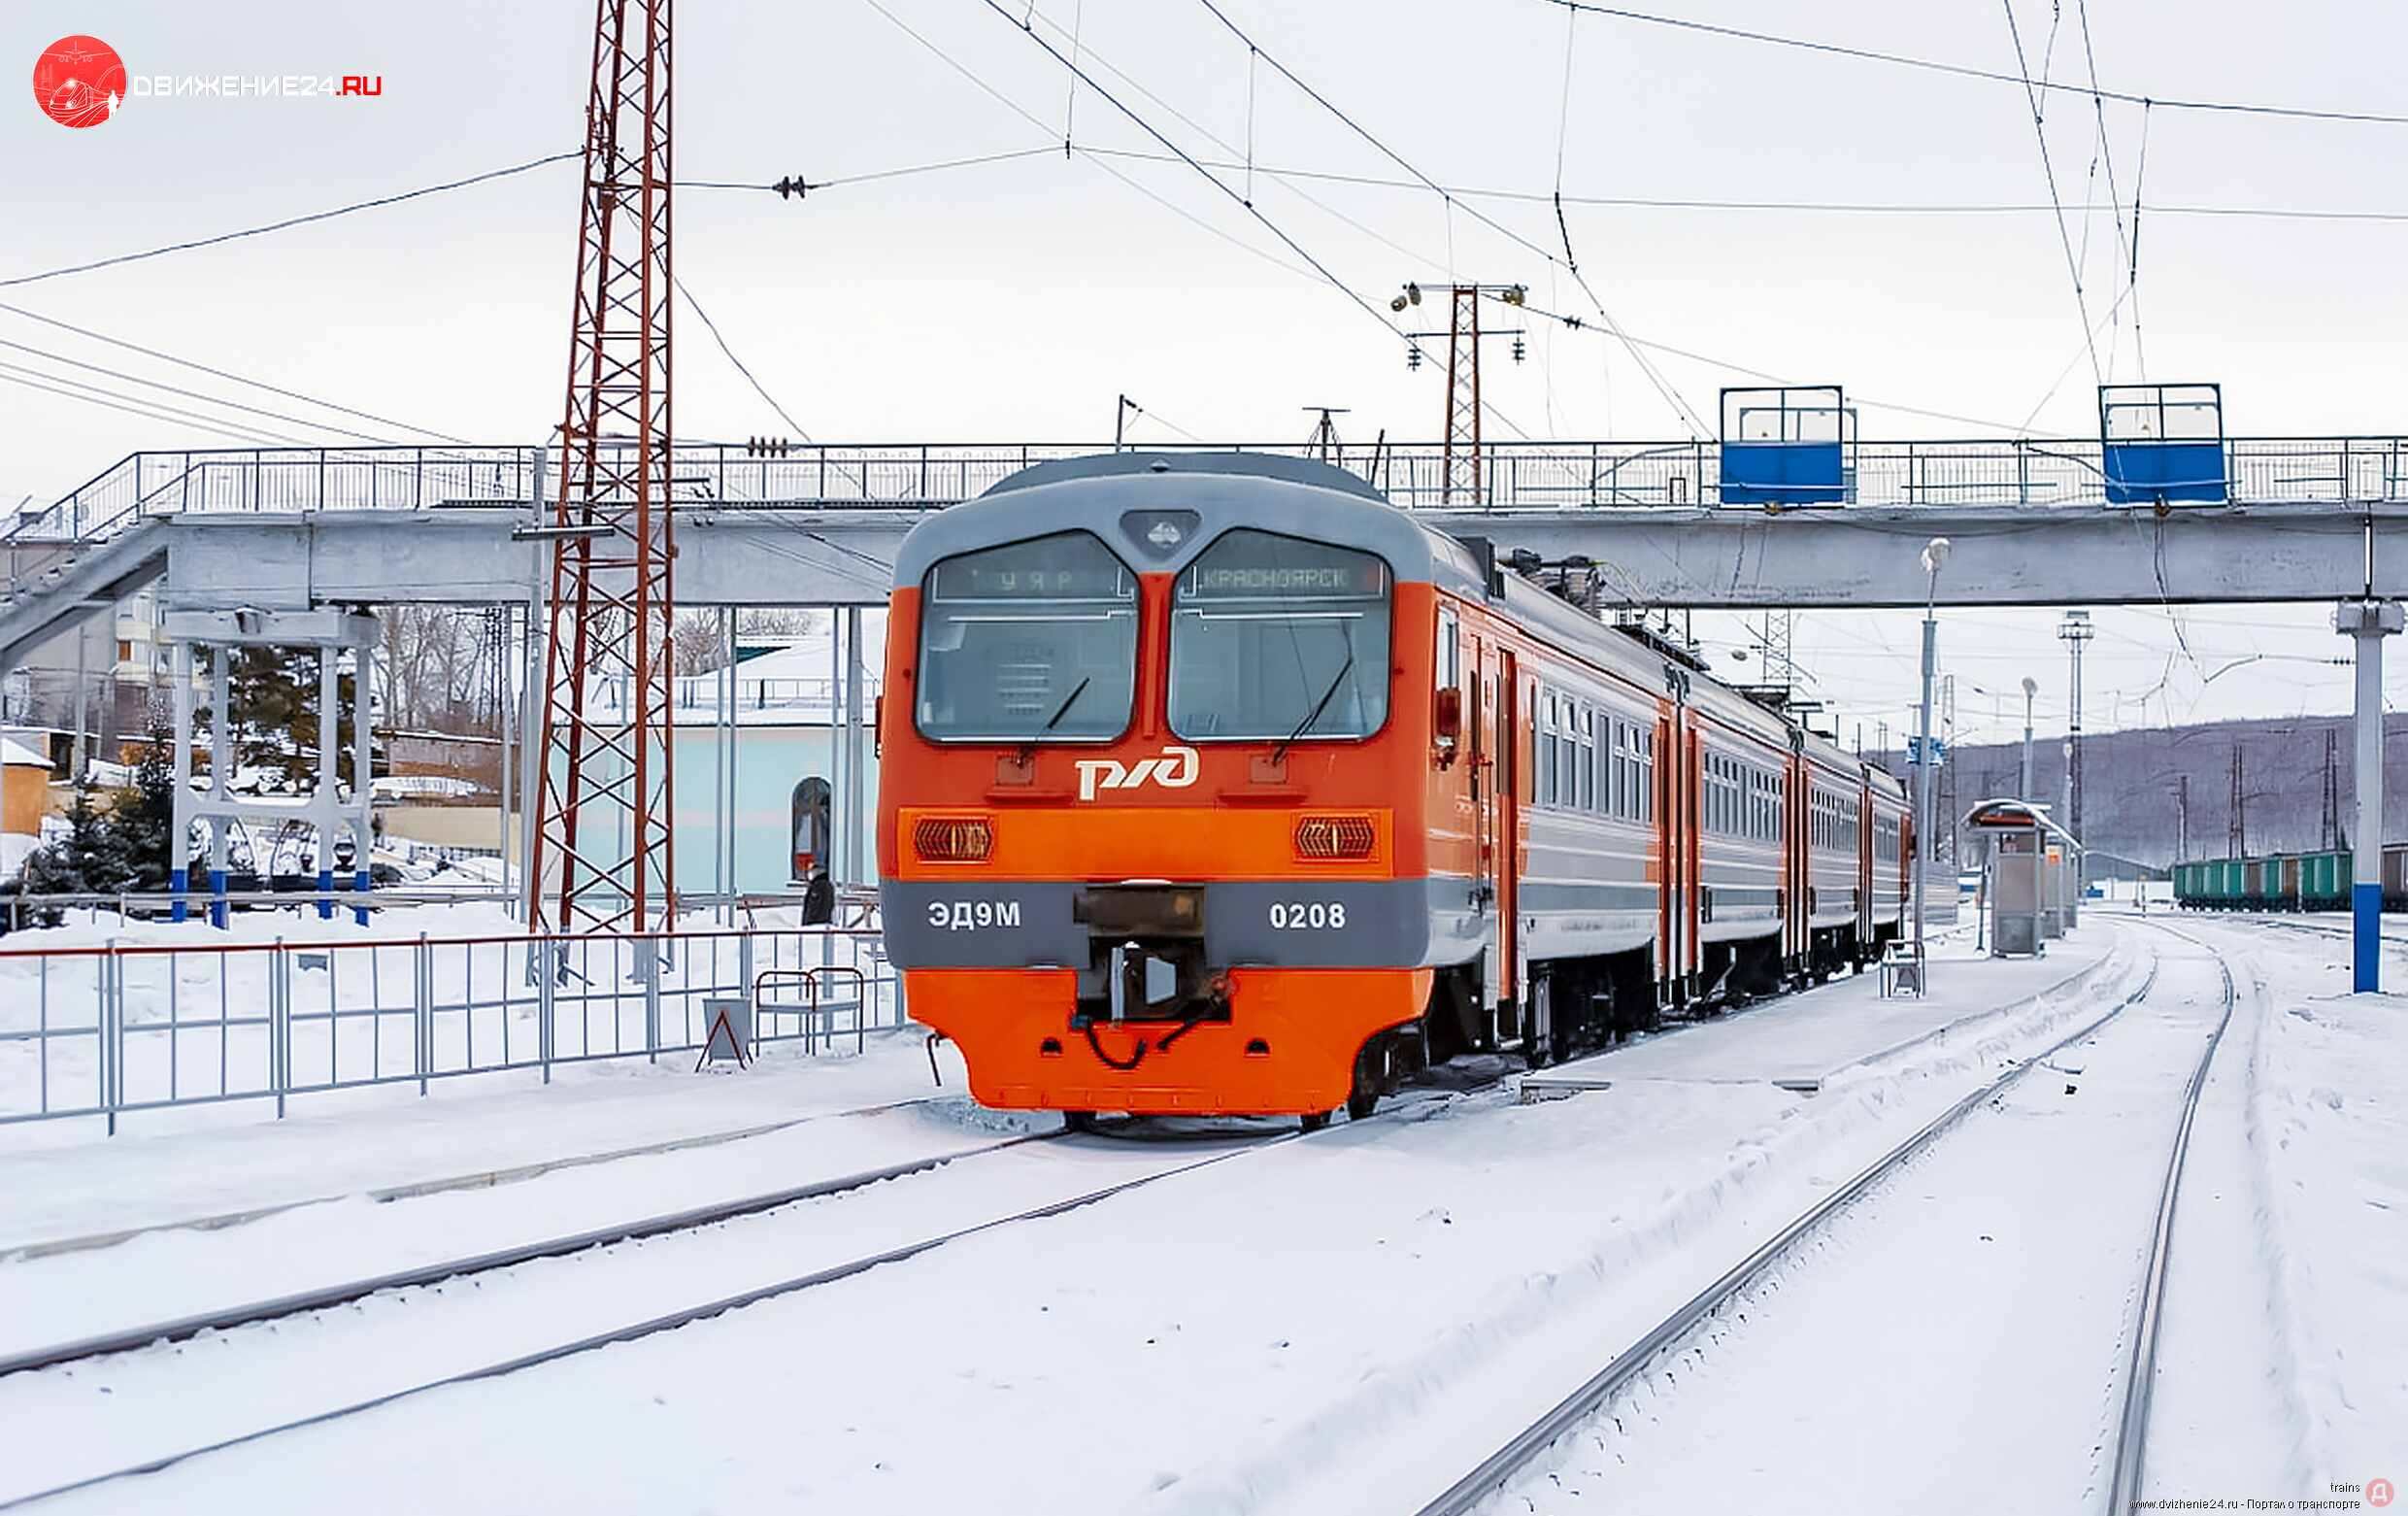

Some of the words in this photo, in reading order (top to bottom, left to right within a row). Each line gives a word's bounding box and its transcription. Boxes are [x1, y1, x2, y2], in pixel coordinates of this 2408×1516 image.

[1203, 567, 1351, 589] КРАСНОЯРСК
[927, 901, 1021, 930] ЭД9М
[1269, 903, 1347, 929] 0208
